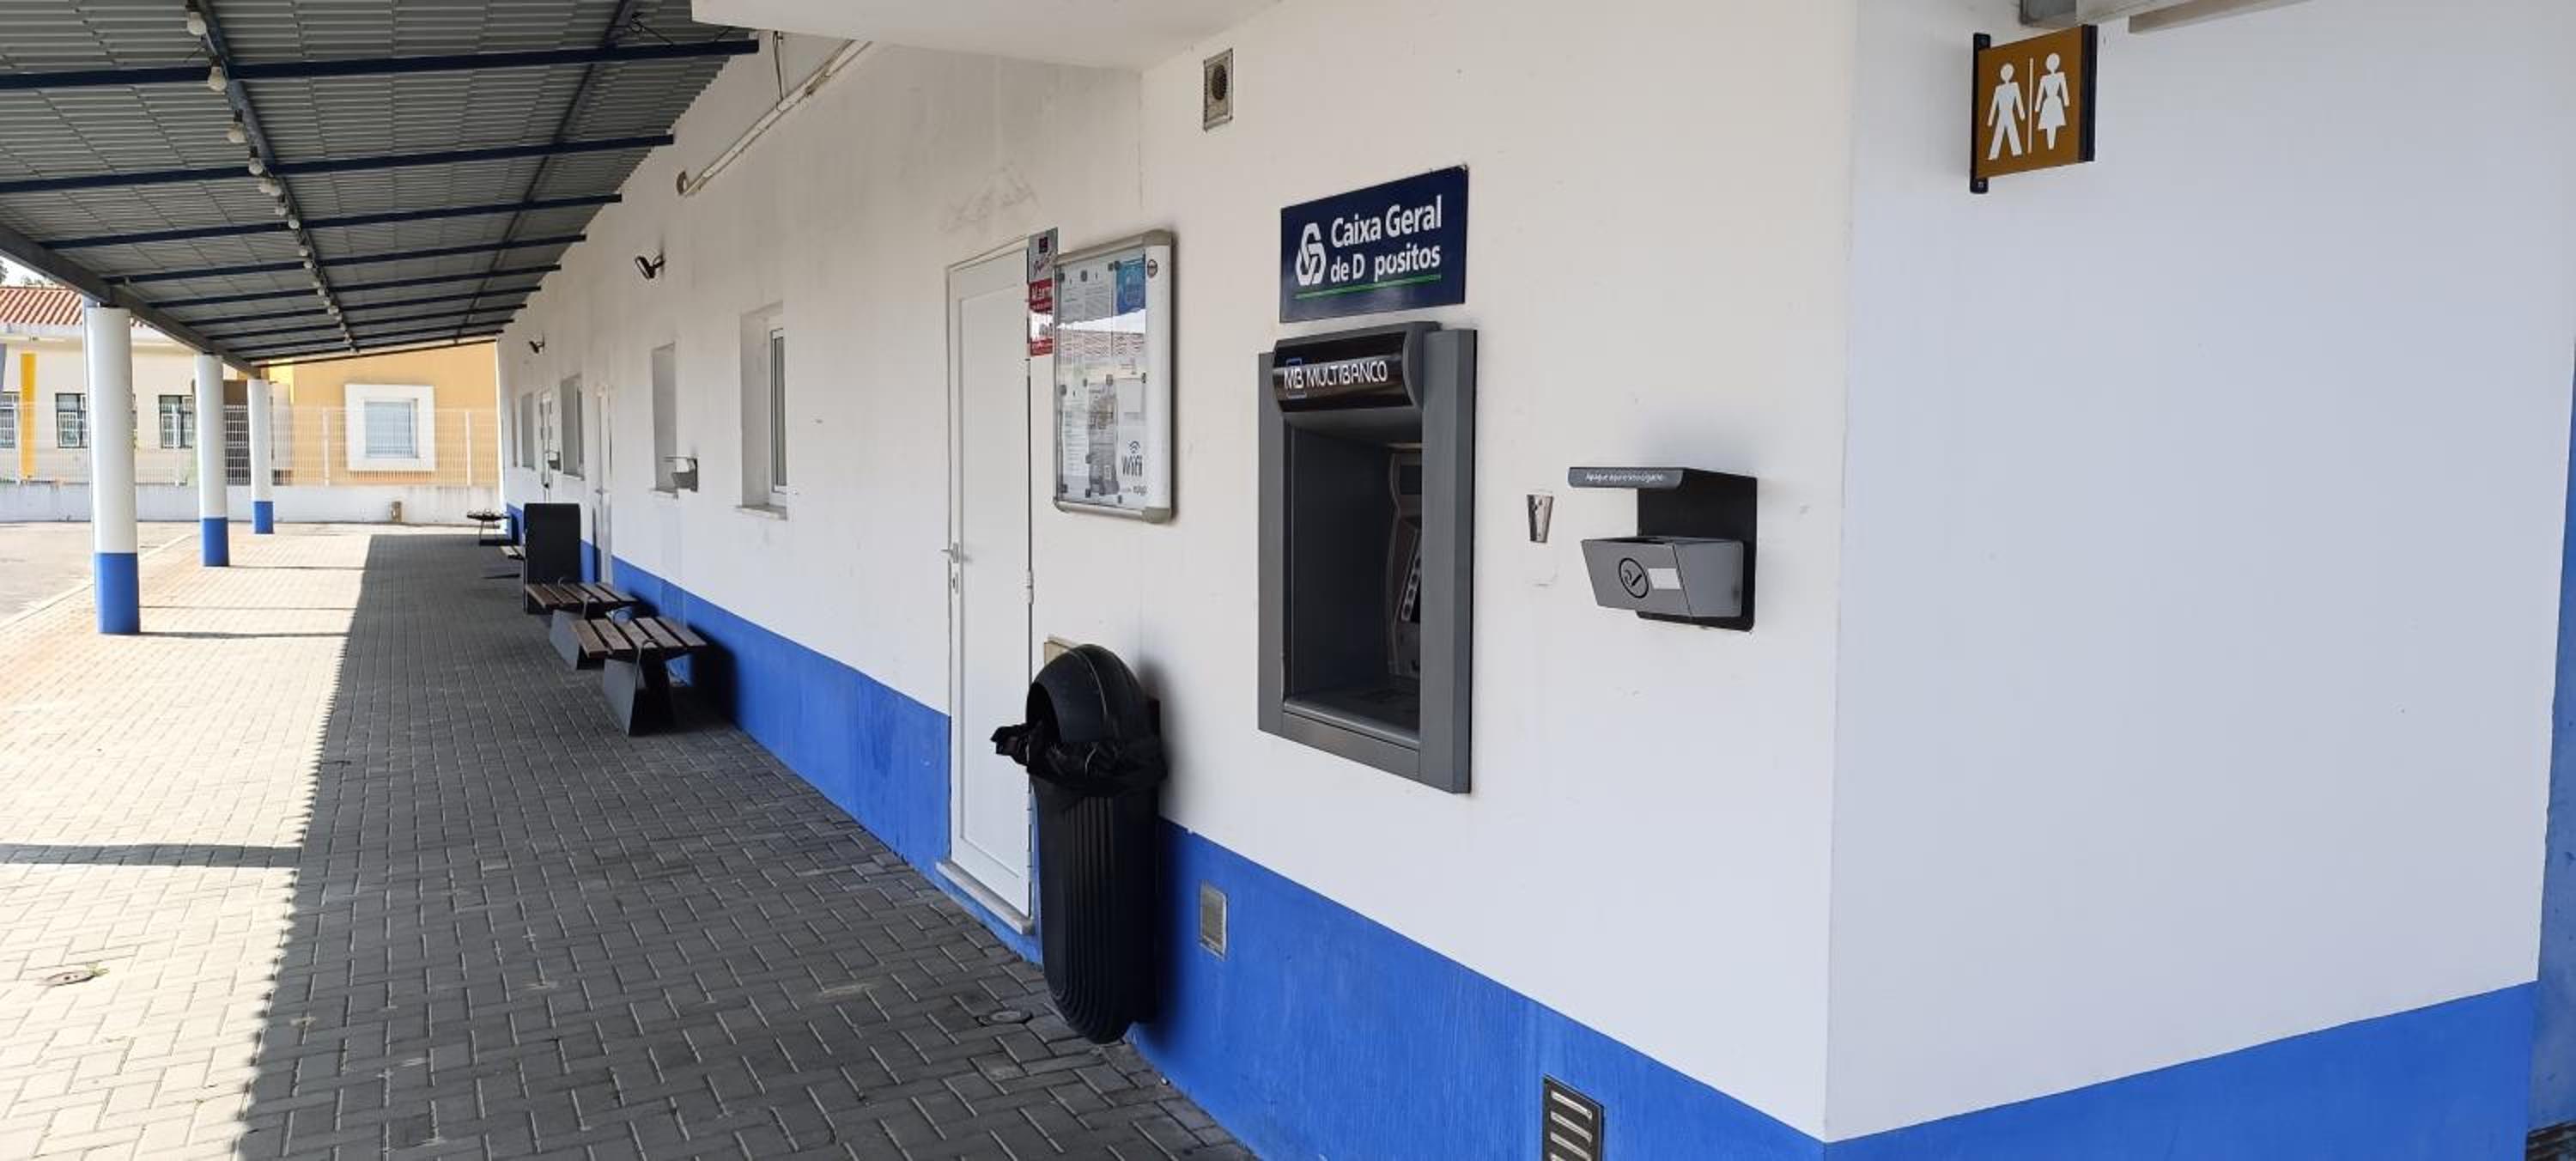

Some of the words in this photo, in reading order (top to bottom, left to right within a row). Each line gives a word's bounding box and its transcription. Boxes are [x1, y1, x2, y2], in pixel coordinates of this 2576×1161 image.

[1331, 213, 1382, 248] Caixa
[1385, 194, 1443, 238] Geral
[1330, 255, 1349, 283] de
[1284, 367, 1304, 390] MB
[1306, 361, 1388, 388] MULTIBANCO
